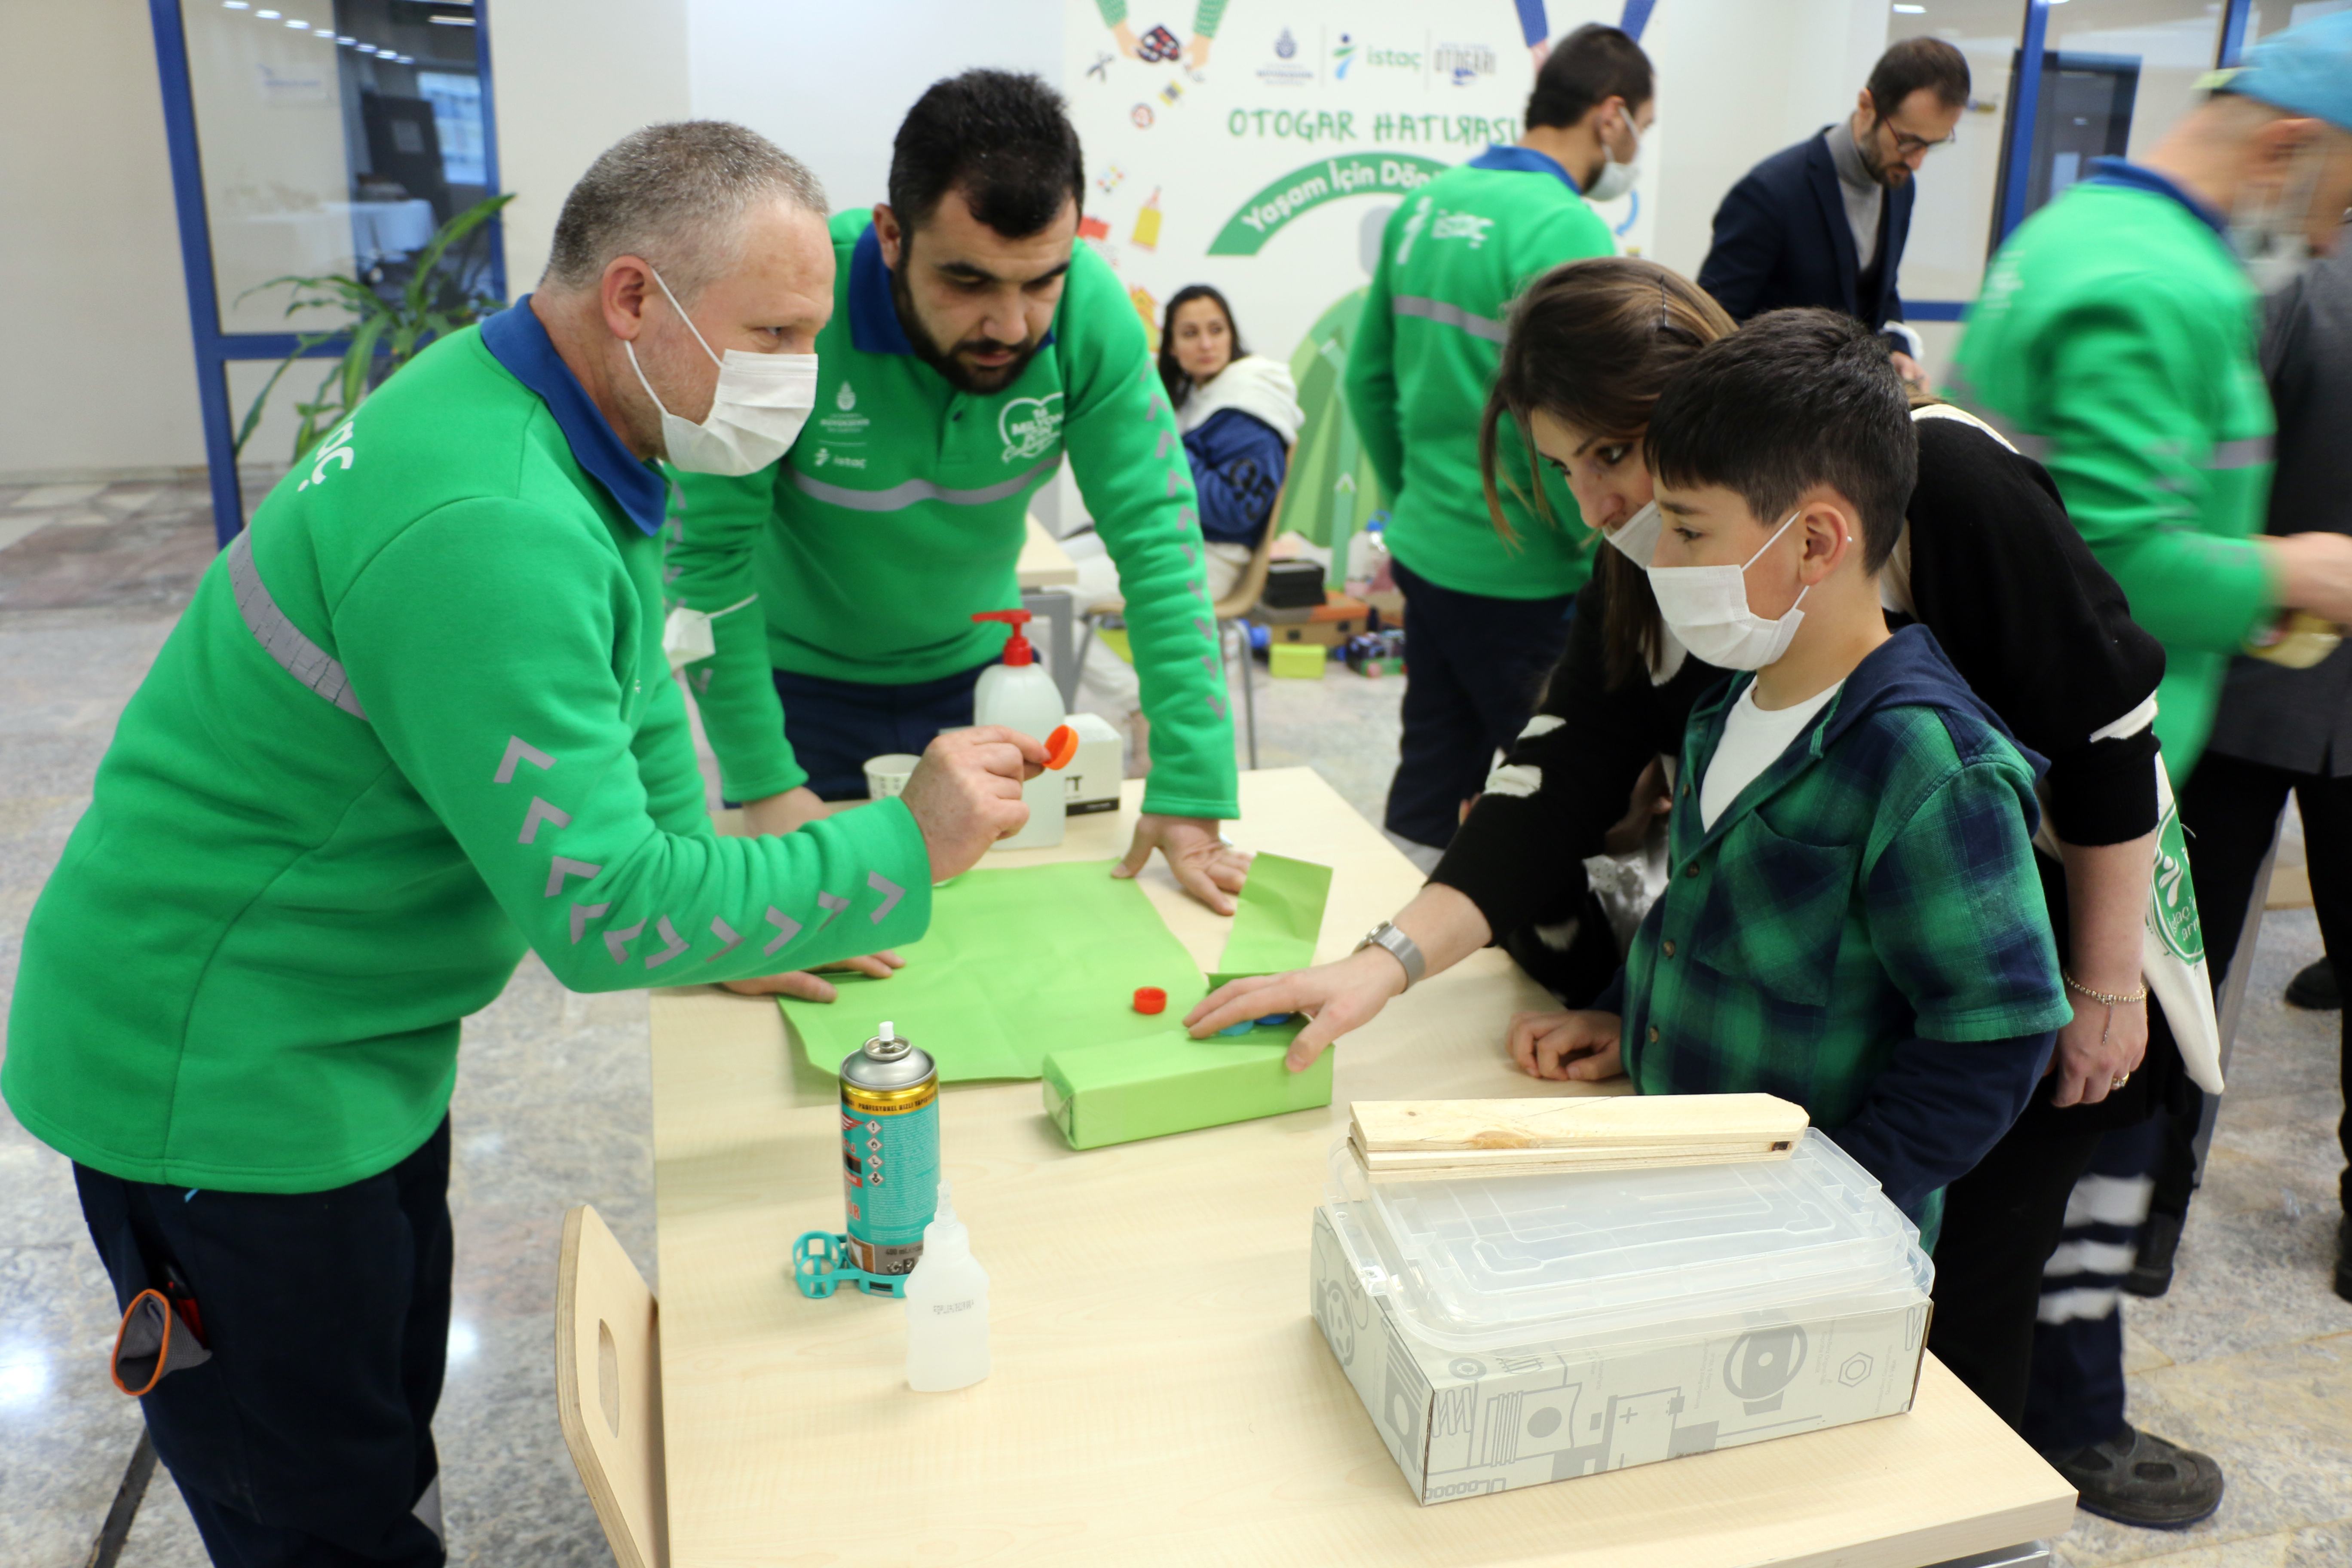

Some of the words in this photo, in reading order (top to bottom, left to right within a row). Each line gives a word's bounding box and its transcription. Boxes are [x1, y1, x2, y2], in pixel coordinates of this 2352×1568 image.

[1367, 46, 1422, 72] istaç
[1228, 108, 1357, 144] OTOGAR
[1241, 174, 1329, 233] Yaşam
[1328, 159, 1375, 194] İçin
